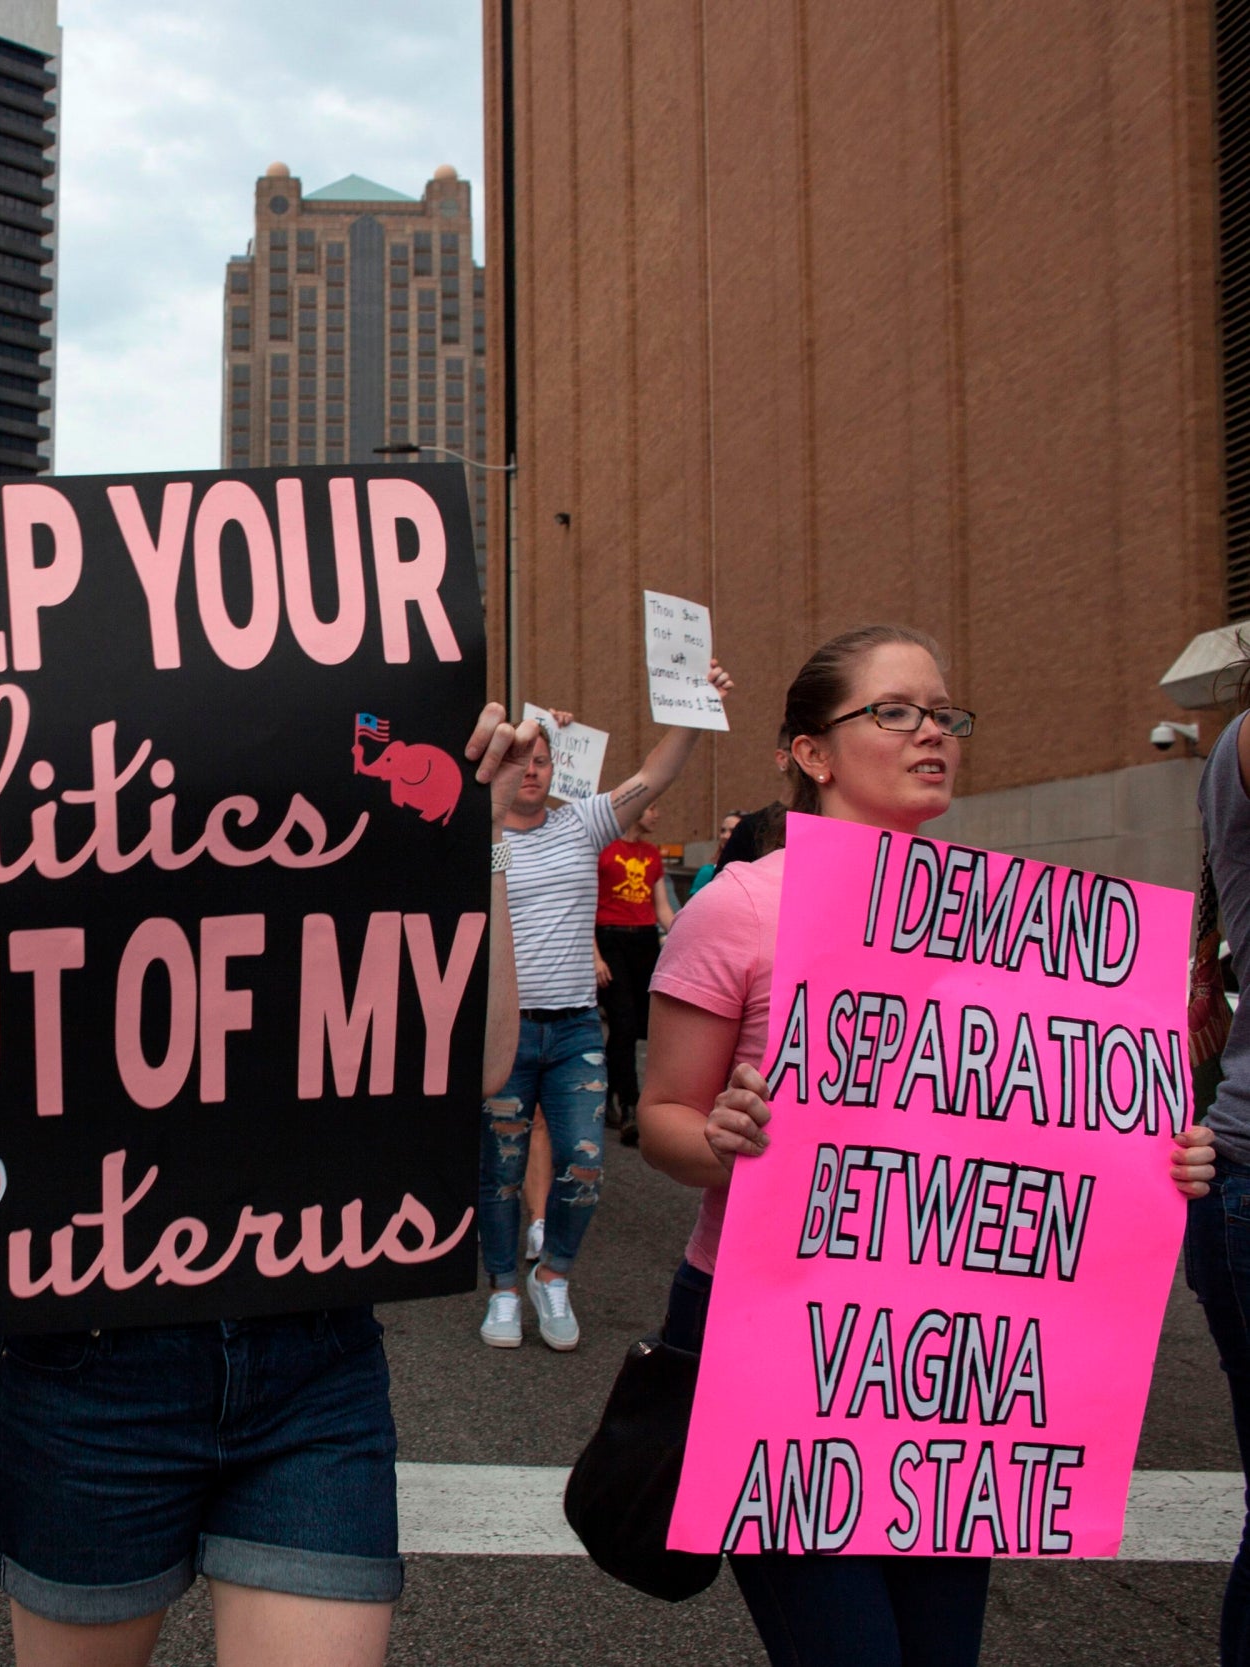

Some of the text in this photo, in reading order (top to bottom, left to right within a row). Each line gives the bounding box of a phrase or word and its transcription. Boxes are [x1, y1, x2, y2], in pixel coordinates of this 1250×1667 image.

[107, 478, 462, 671] YOUR
[862, 831, 1141, 987] I DEMAND
[115, 913, 266, 1110] OF
[298, 911, 487, 1100] MY
[767, 980, 1187, 1138] A SEPARATION
[8, 1149, 474, 1299] uterus
[796, 1143, 1096, 1283] BETWEEN
[805, 1301, 1047, 1429] VAGINA
[721, 1437, 1087, 1556] AND STATE
